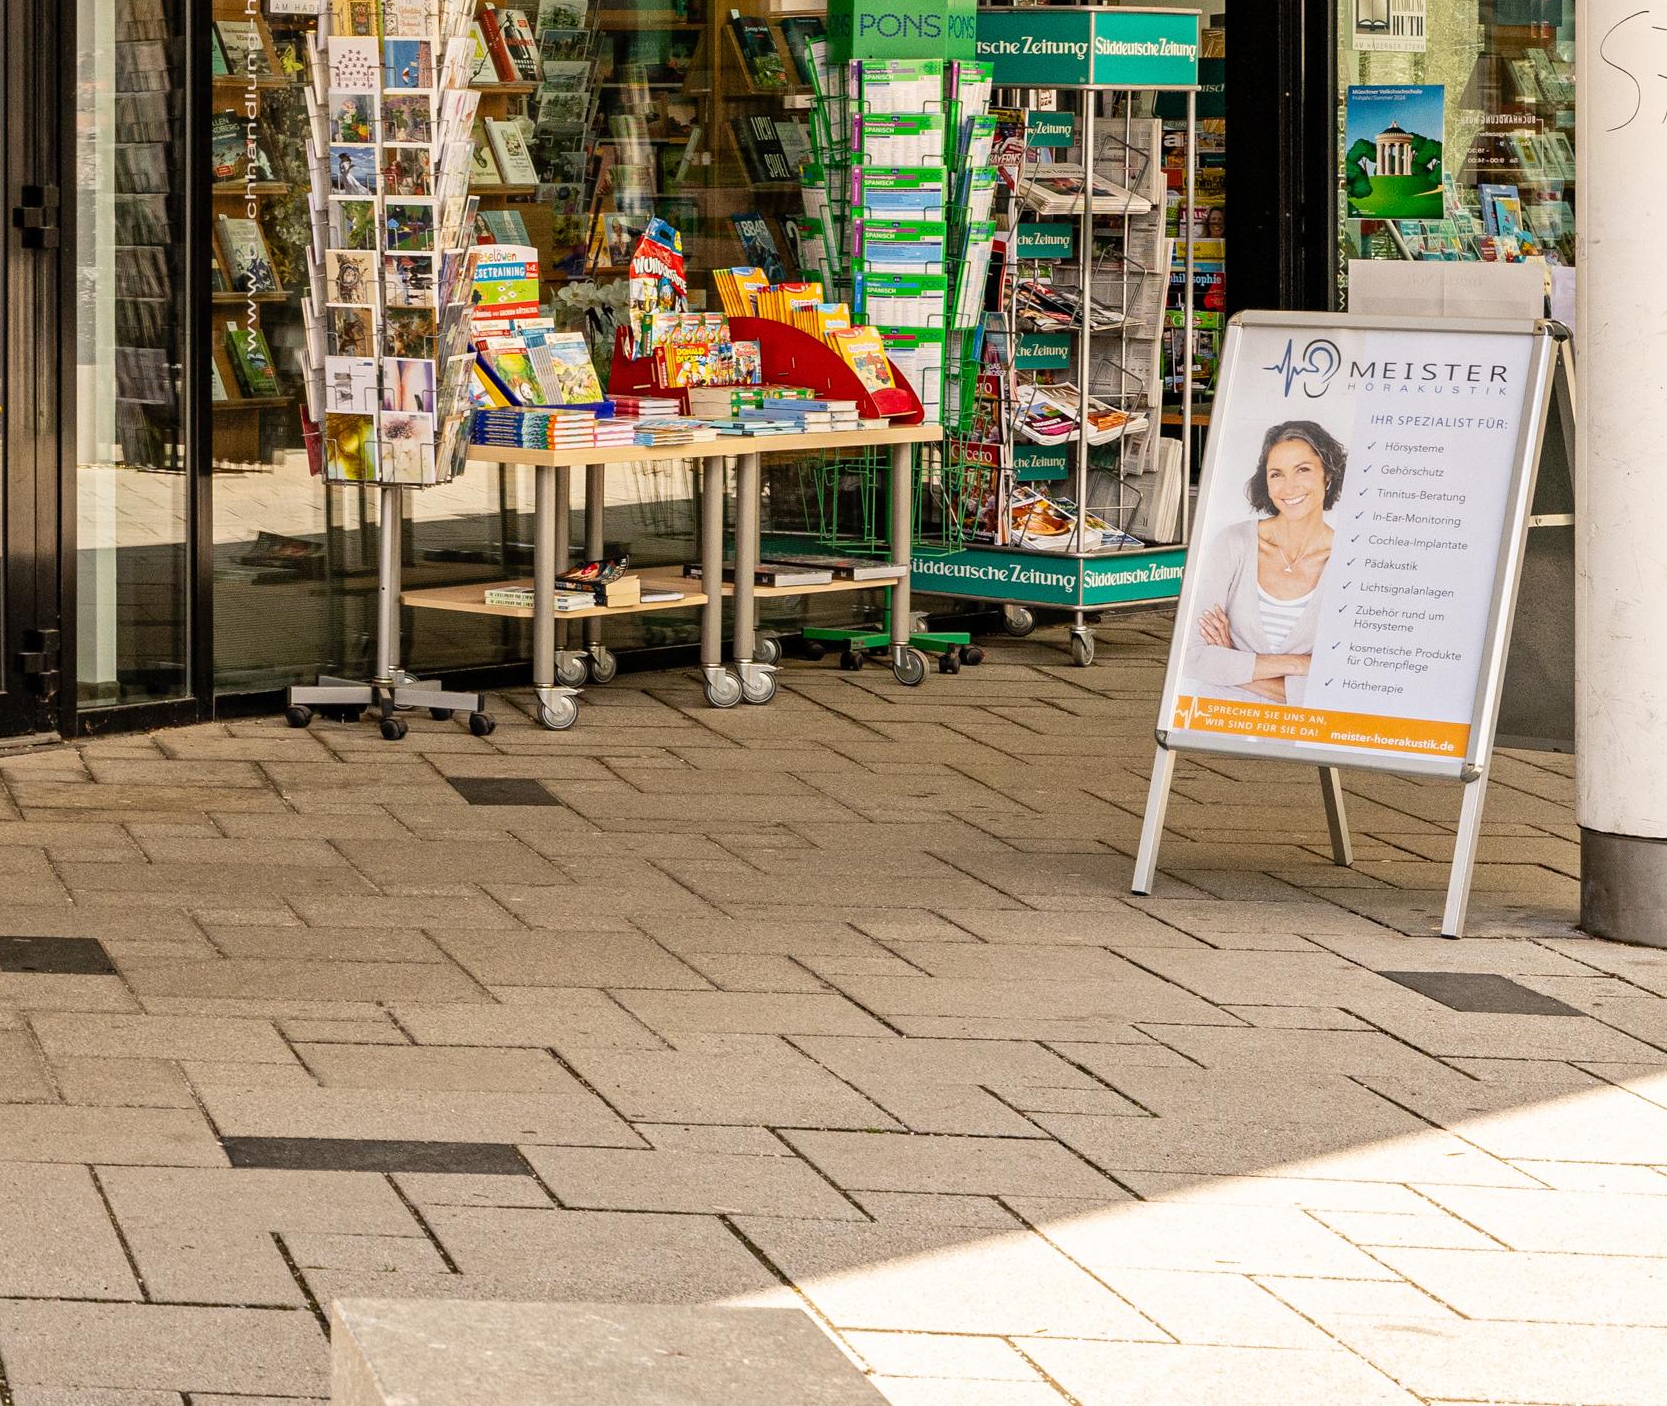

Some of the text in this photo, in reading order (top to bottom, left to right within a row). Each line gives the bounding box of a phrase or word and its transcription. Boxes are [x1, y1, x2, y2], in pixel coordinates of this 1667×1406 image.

[275, 2, 289, 11] AM
[859, 13, 975, 40] PONS PONS
[1392, 15, 1424, 37] HUTH
[1021, 37, 1089, 60] Zeitung
[1095, 37, 1197, 62] Süddeutsche Zeitung
[751, 116, 777, 141] LICHT
[864, 126, 895, 134] SPANISCH
[1035, 121, 1072, 138] Zeitung
[764, 152, 791, 178] SPIEL
[741, 220, 767, 237] 8849
[1034, 232, 1071, 249] Zeitung
[477, 248, 517, 263] eselöwen
[474, 265, 525, 280] ESETRAINING
[1168, 273, 1222, 287] philsophie
[676, 347, 705, 356] DONALD
[1032, 342, 1069, 360] Zeitung
[1349, 361, 1507, 383] MEISTER
[1347, 380, 1507, 396] HÖRAKUSTIK
[1371, 414, 1508, 429] IHR SPEZIALIST FÜR:
[951, 443, 993, 464] Cicero
[1385, 442, 1444, 454] Hörsysteme
[1030, 455, 1066, 473] Zeitung
[1381, 464, 1444, 477] Gehörschutz
[1378, 488, 1466, 505] Tinnitus-Beratung
[1372, 512, 1462, 528] In-Ear-Monitoring
[1368, 535, 1468, 551] Cochlea-Implantate
[1364, 558, 1418, 571] Pädakustik
[1009, 564, 1077, 592] Zeitung
[1083, 569, 1149, 588] Süddeutsche
[1360, 582, 1455, 599] Lichtsignalanlagen
[1355, 605, 1445, 622] Zubehör rund um
[1354, 619, 1414, 633] Hörsysteme
[1349, 642, 1462, 662] kosmetische Produkte
[1347, 655, 1429, 673] für Ohrenpflege
[1342, 679, 1404, 695] Hörtherapie
[1207, 704, 1328, 726] SPRECHEN SIE UNS AN,
[1205, 717, 1319, 737] WIR SIND FÜR SIE DA!
[1330, 730, 1455, 752] meister-hoerakustik.de
